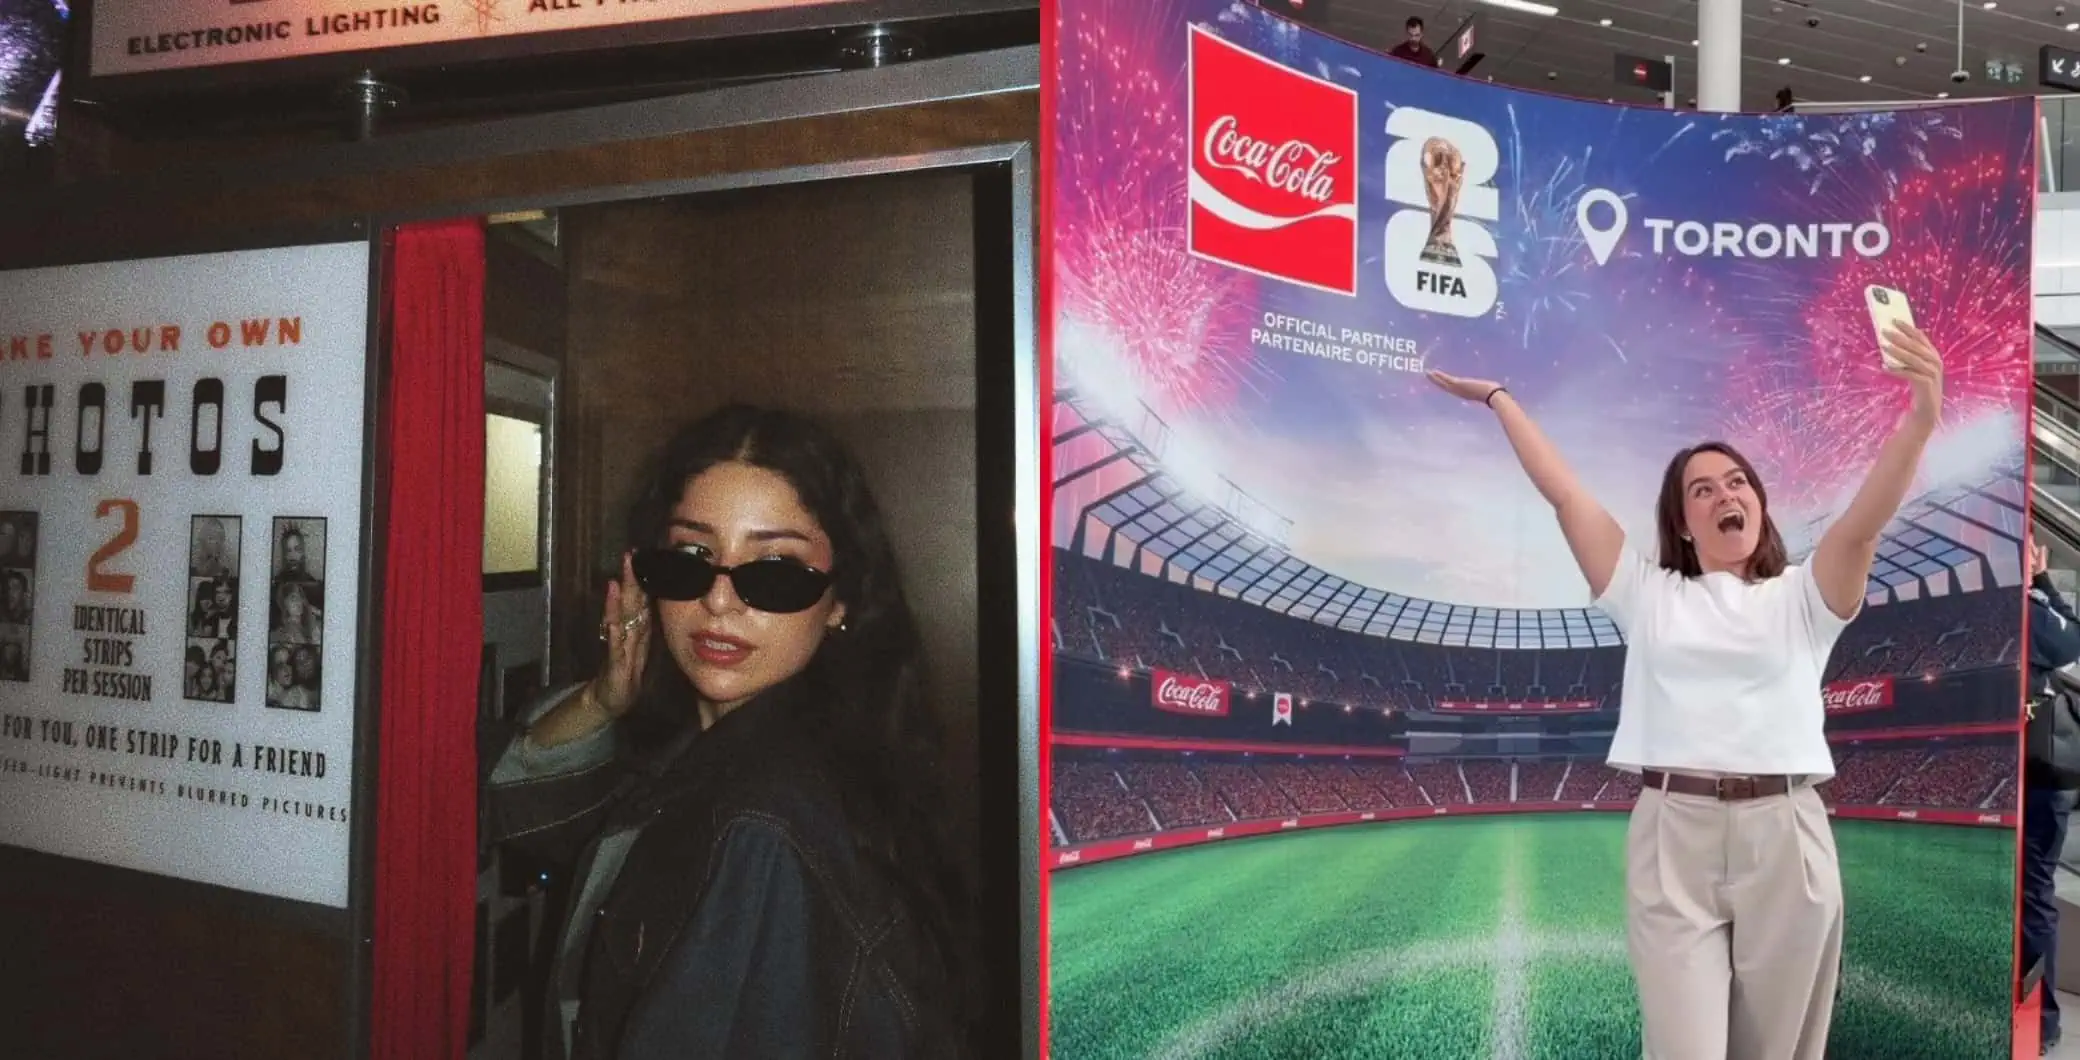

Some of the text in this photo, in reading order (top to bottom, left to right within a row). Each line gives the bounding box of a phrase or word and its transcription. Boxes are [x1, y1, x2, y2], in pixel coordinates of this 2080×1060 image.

[127, 21, 292, 56] ELECTRONIC
[305, 4, 440, 36] LIGHTING
[1203, 114, 1343, 203] Coca-Cola
[1643, 217, 1890, 258] TORONTO
[1416, 270, 1467, 298] FIFA
[0, 316, 301, 361] KE YOUR OWN
[1251, 328, 1353, 363] PARTENAIRE
[1263, 312, 1418, 355] OFFICIAL PARTNER
[20, 375, 287, 476] HOTOS
[85, 498, 140, 593] 2
[73, 605, 146, 635] IDENTICAL
[83, 638, 133, 667] STRIPS
[62, 667, 152, 702] PER SESSION
[3, 714, 326, 779] FOR YOU, ONE STRIP FOR A FRIEND
[90, 771, 165, 795] PREVENTS
[178, 784, 248, 808] BLURRED
[262, 797, 348, 823] PICTURES
